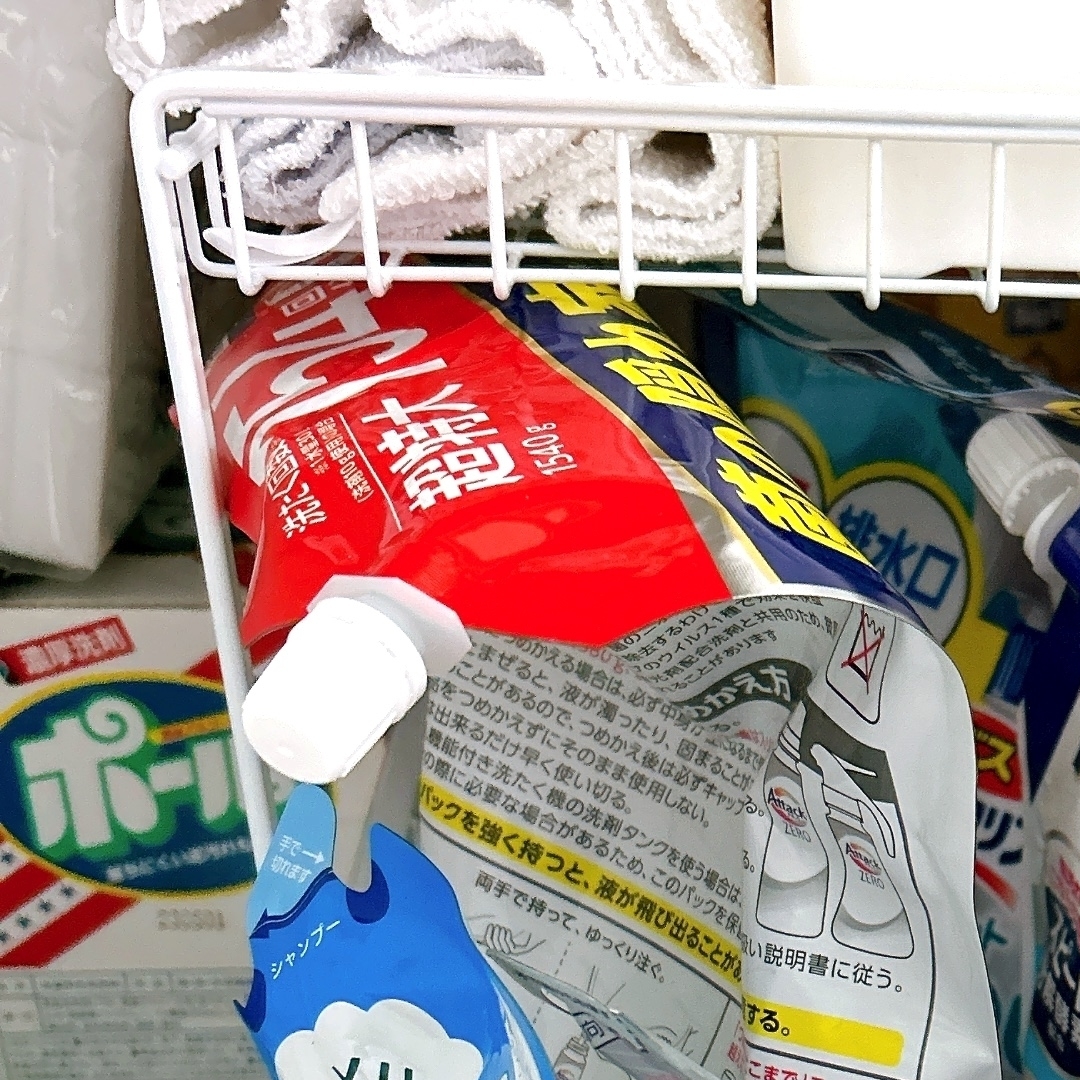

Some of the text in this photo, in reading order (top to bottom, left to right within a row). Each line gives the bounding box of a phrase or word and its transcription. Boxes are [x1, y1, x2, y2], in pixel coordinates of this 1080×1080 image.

[361, 383, 525, 512] 超特大
[767, 787, 808, 821] Attack
[278, 832, 301, 854] 手で
[269, 854, 313, 884] 切れます
[270, 918, 342, 981] シャンプー
[475, 868, 667, 984] 両手で持って、ゆっくり注ぐ。
